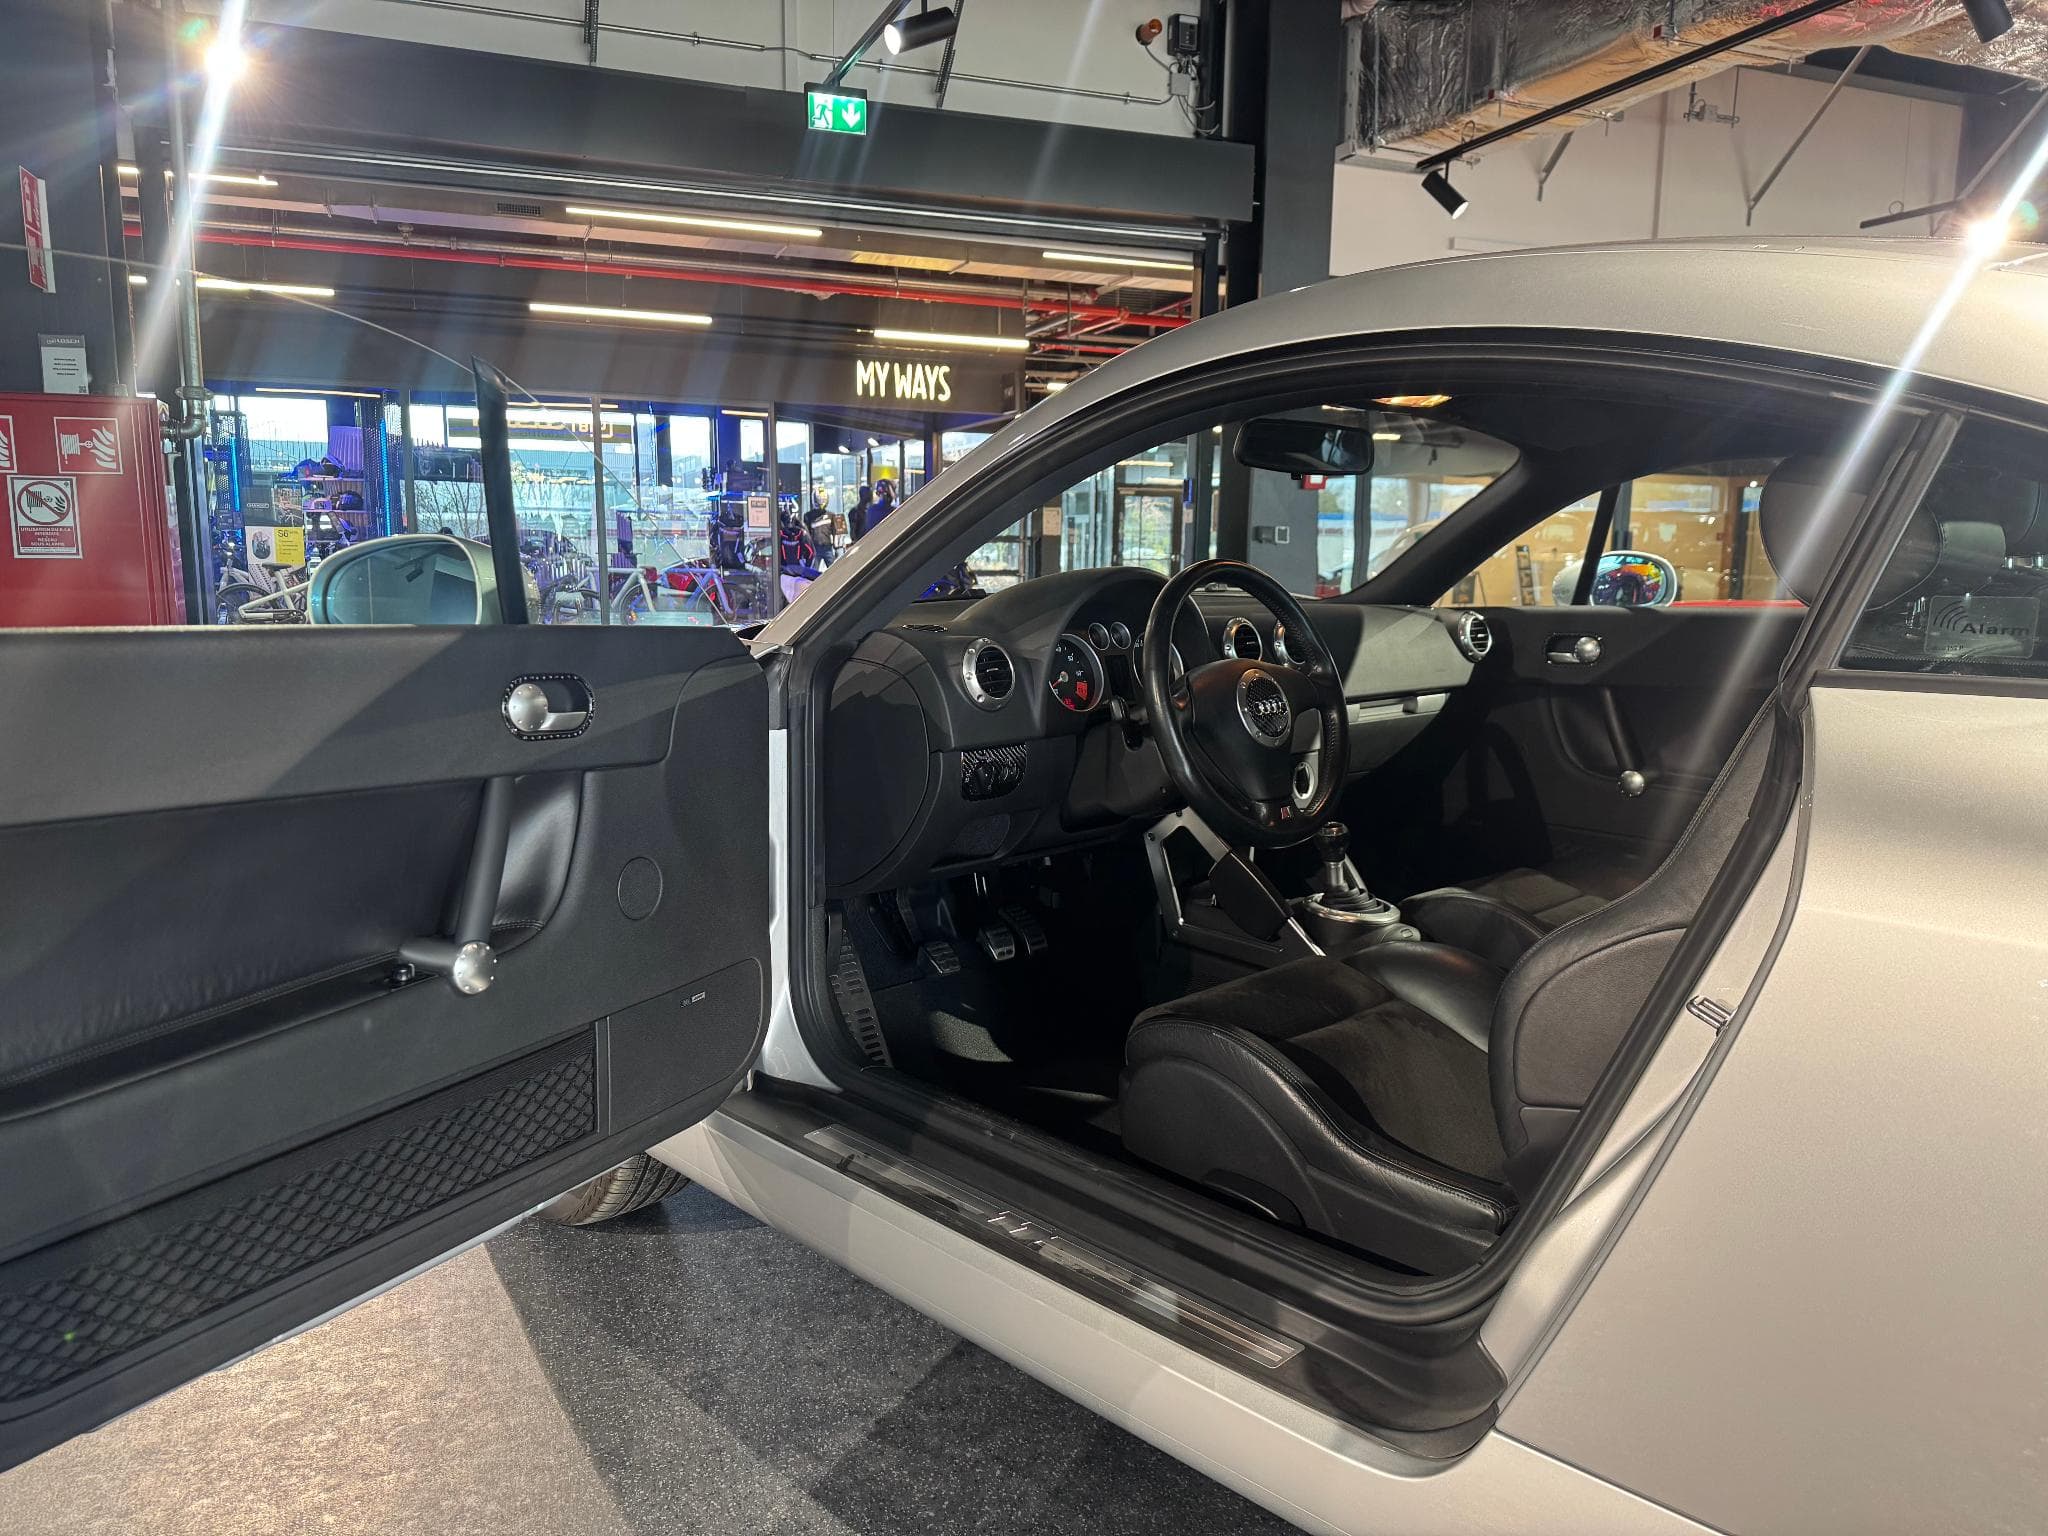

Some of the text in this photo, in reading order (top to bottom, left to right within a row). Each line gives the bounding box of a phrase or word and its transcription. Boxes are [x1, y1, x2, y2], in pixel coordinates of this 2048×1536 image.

[856, 360, 951, 401] MY WAYS
[1960, 622, 2030, 637] Alarm
